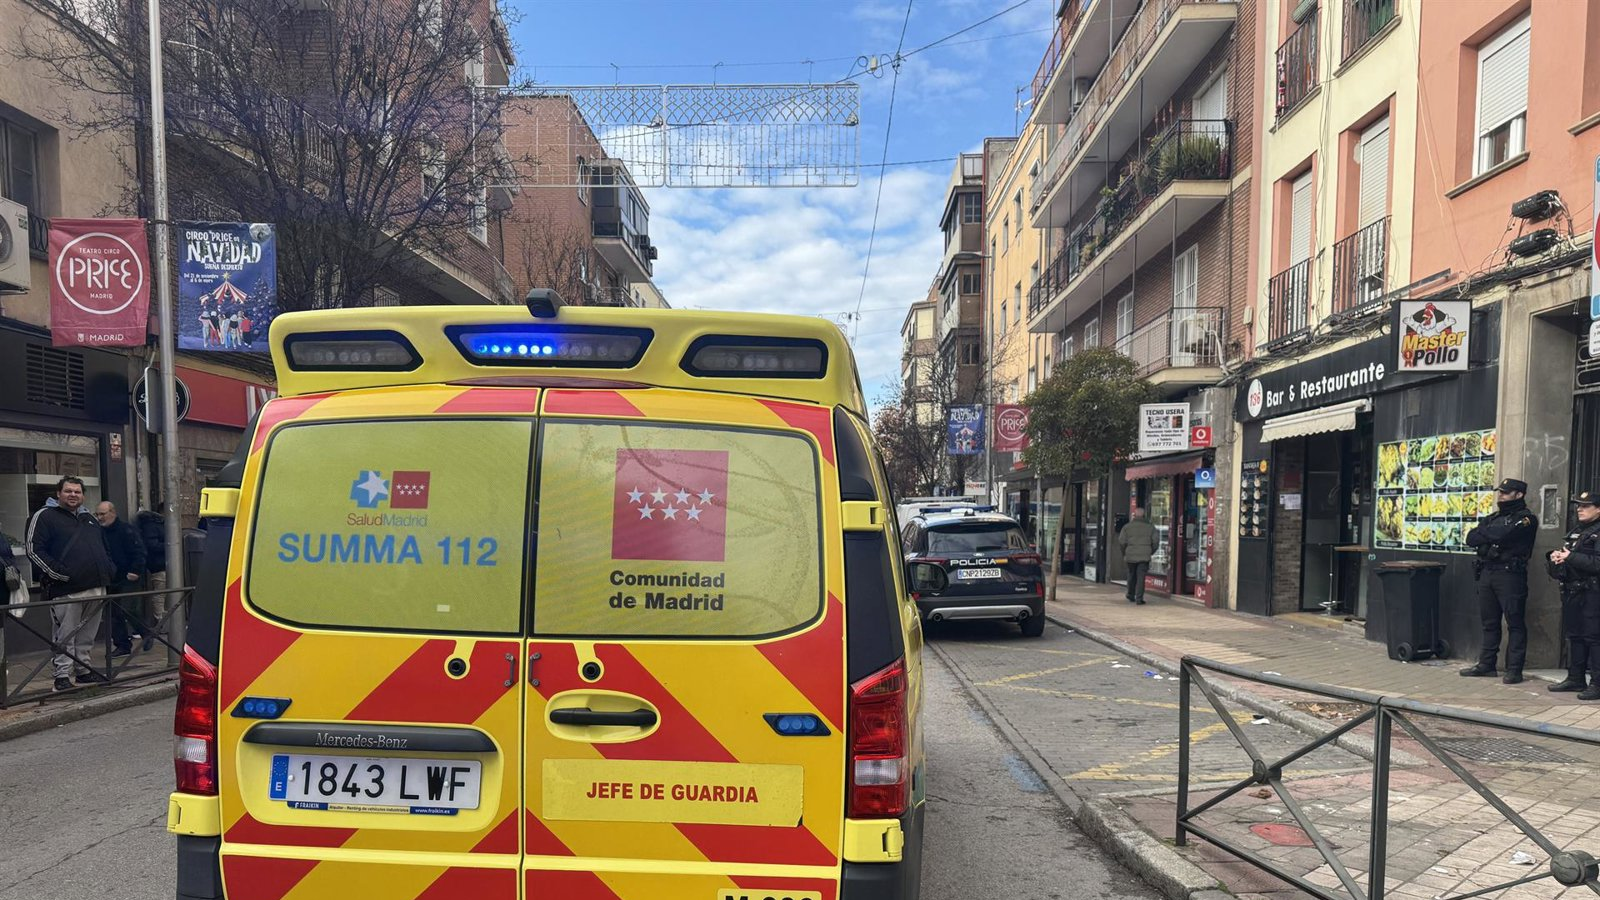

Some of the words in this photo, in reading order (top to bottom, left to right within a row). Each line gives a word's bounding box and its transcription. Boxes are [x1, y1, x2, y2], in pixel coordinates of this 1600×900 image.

[186, 231, 208, 240] CIRCO
[211, 232, 233, 241] PRICE
[186, 241, 262, 264] NAVIDAD
[69, 257, 132, 289] PRICE
[89, 333, 124, 342] MADRID
[1402, 331, 1467, 351] Master
[1412, 346, 1459, 367] Pollo
[1266, 390, 1284, 407] Bar
[1289, 384, 1296, 401] &
[1300, 362, 1385, 399] Restaurante
[347, 513, 427, 527] SaludMadrid
[278, 532, 423, 564] SUMMA
[437, 536, 498, 566] 112
[950, 558, 997, 566] POLICIA
[609, 570, 725, 588] Comunidad
[609, 592, 636, 609] de
[644, 592, 724, 611] Madrid
[315, 732, 408, 748] Mercedes-Benz
[275, 782, 283, 792] E
[301, 761, 385, 798] 1843
[400, 765, 471, 801] LWF
[587, 782, 633, 799] JEFE
[640, 783, 665, 800] DE
[671, 784, 759, 803] GUARDIA
